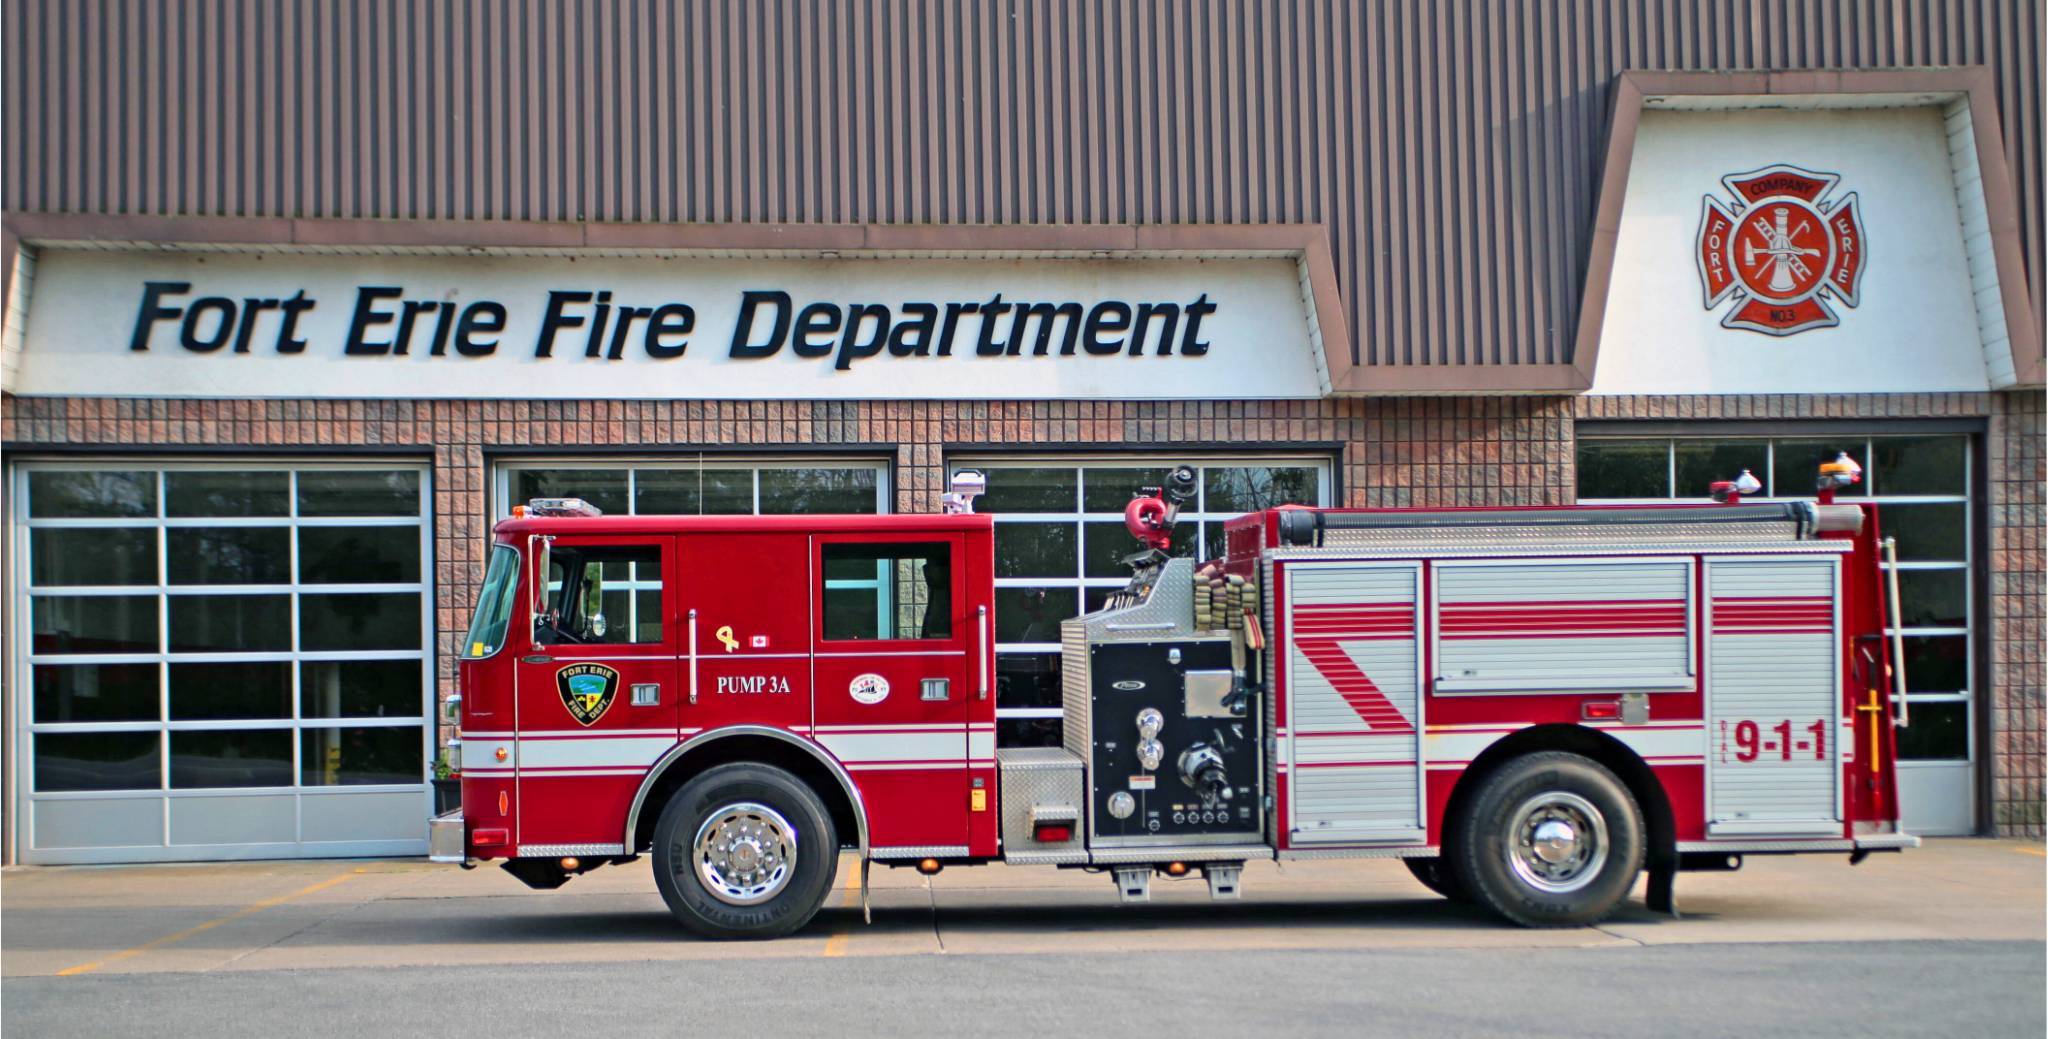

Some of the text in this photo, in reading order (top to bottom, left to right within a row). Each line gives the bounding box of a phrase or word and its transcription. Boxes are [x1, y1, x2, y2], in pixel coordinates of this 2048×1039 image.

[1751, 179, 1814, 195] COMPANY
[1709, 220, 1725, 282] FORT
[1836, 218, 1853, 283] ERIE
[130, 281, 1217, 370] Fort Erie Fire Department
[561, 666, 613, 679] FORT ERIE
[717, 675, 791, 694] PUMP 3A
[568, 700, 586, 719] FIRE
[1735, 719, 1825, 762] 9-1-1
